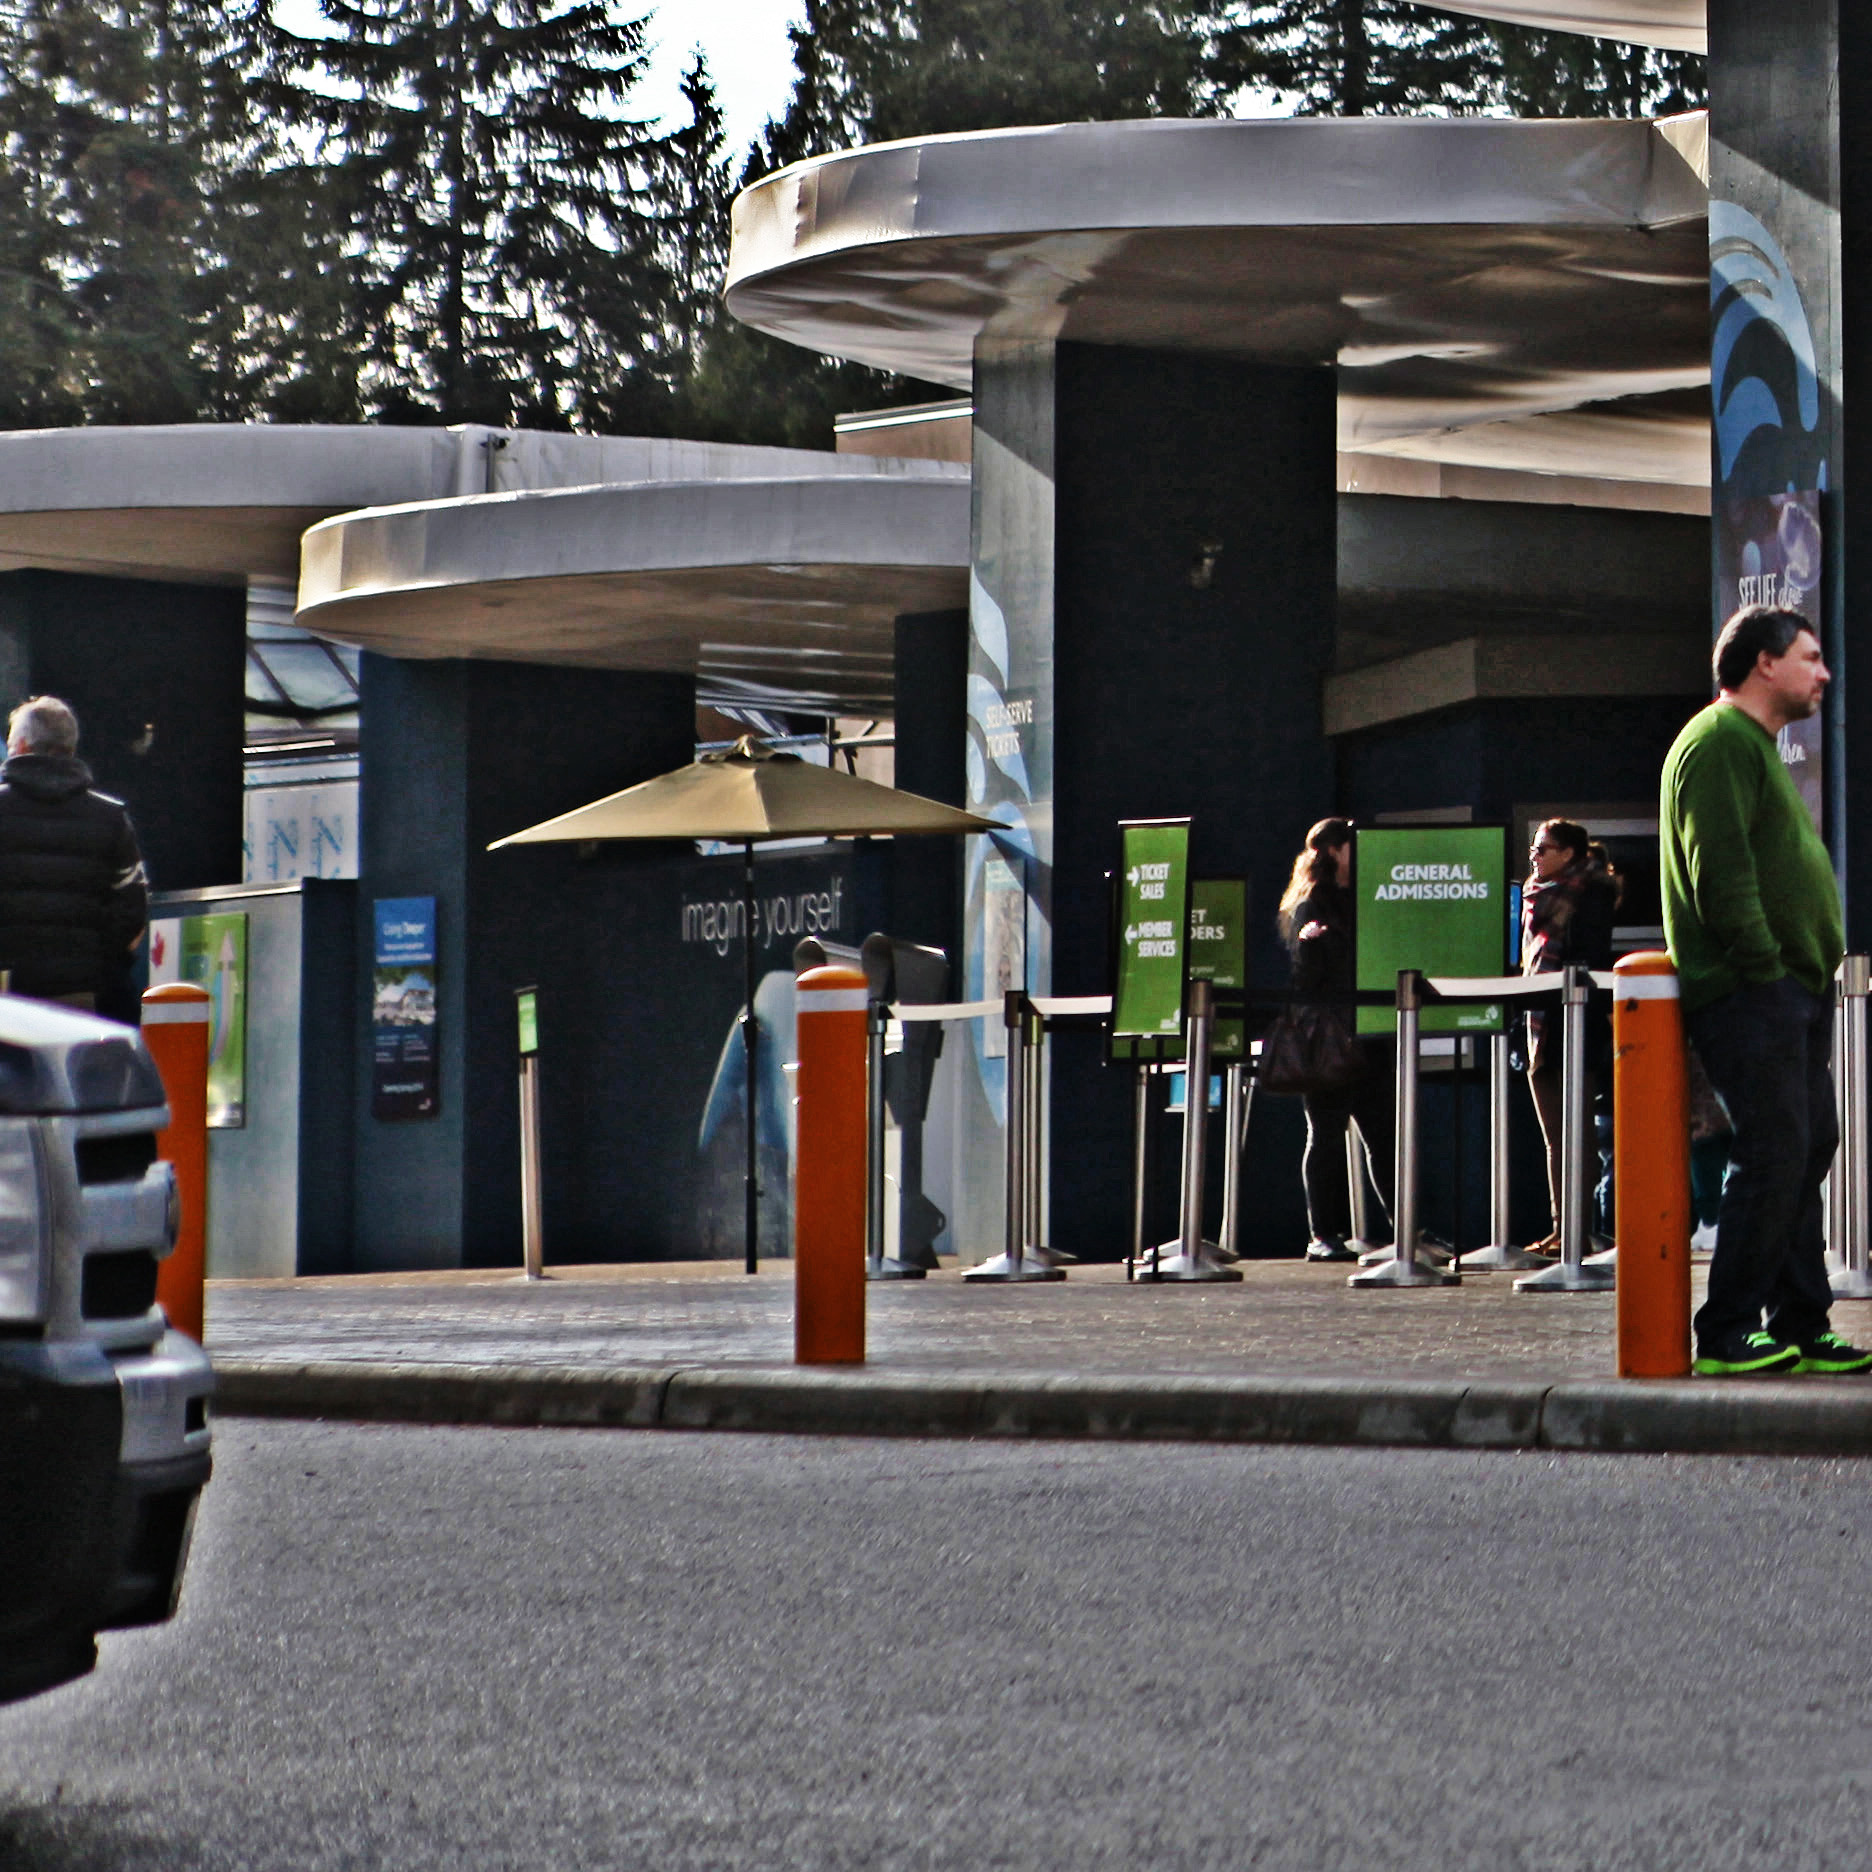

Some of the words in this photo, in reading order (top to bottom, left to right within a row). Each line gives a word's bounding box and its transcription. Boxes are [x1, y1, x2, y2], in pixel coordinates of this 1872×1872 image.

[1390, 864, 1473, 882] GENERAL
[1139, 882, 1165, 900] SALES
[1374, 883, 1489, 901] ADMISSIONS
[763, 876, 843, 949] yourself
